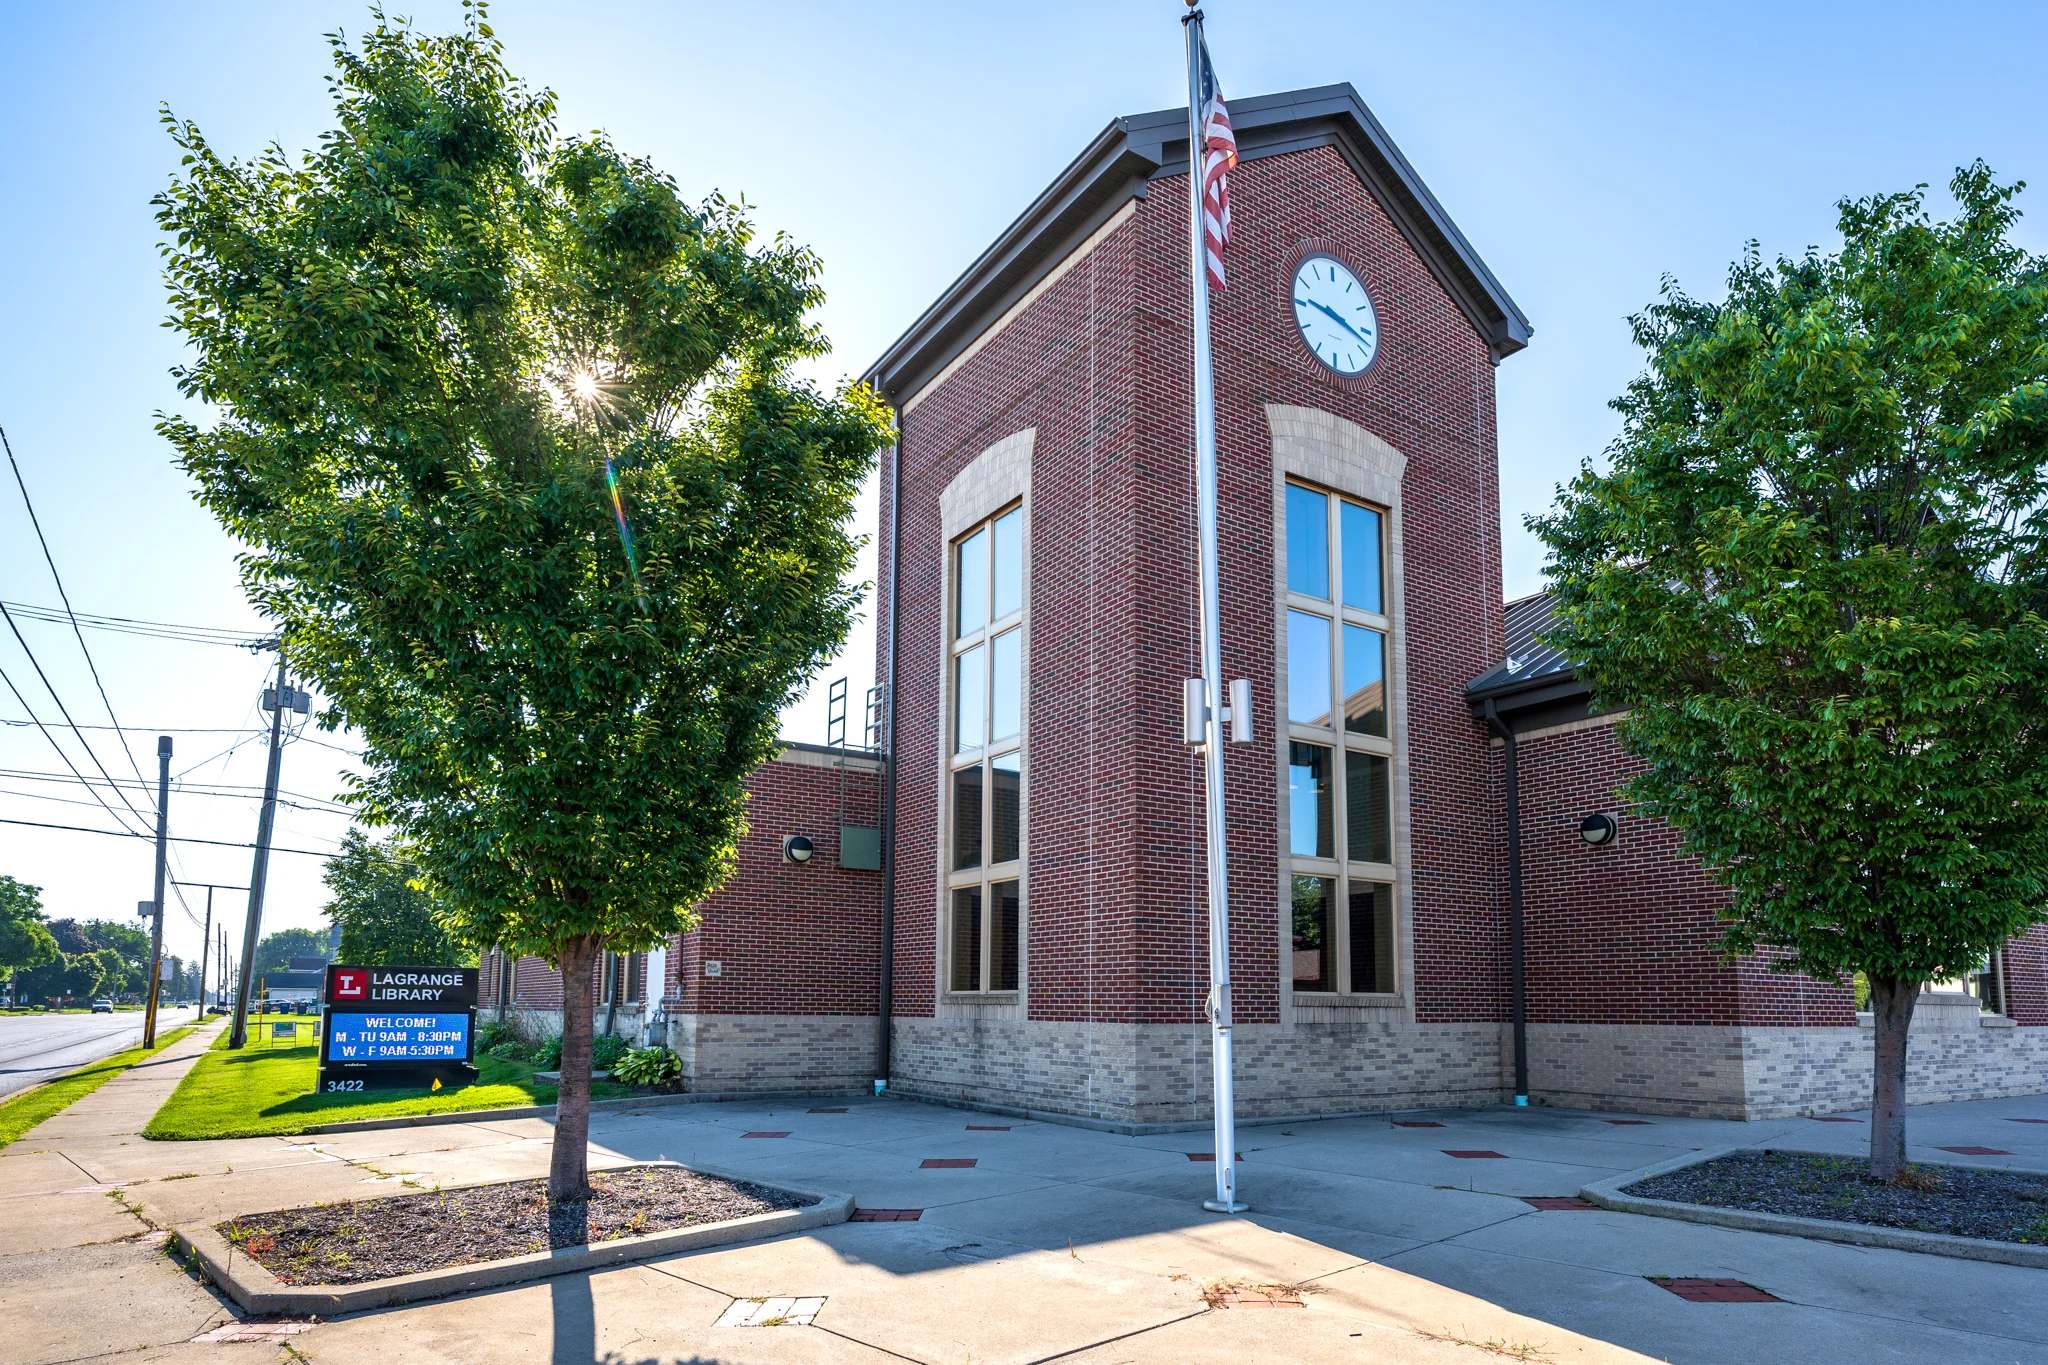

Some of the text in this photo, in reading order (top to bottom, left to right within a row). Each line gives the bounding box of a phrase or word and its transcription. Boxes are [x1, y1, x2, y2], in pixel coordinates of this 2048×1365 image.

[373, 973, 464, 986] LAGRANGE
[372, 988, 443, 1001] LIBRARY
[366, 1018, 436, 1028] WELCOME!
[335, 1032, 347, 1042] M
[359, 1031, 376, 1042] TU
[379, 1031, 407, 1042] 9AM
[417, 1031, 462, 1042] 8:30PM
[342, 1046, 357, 1057] W
[368, 1046, 376, 1056] F
[327, 1080, 364, 1092] 3422
